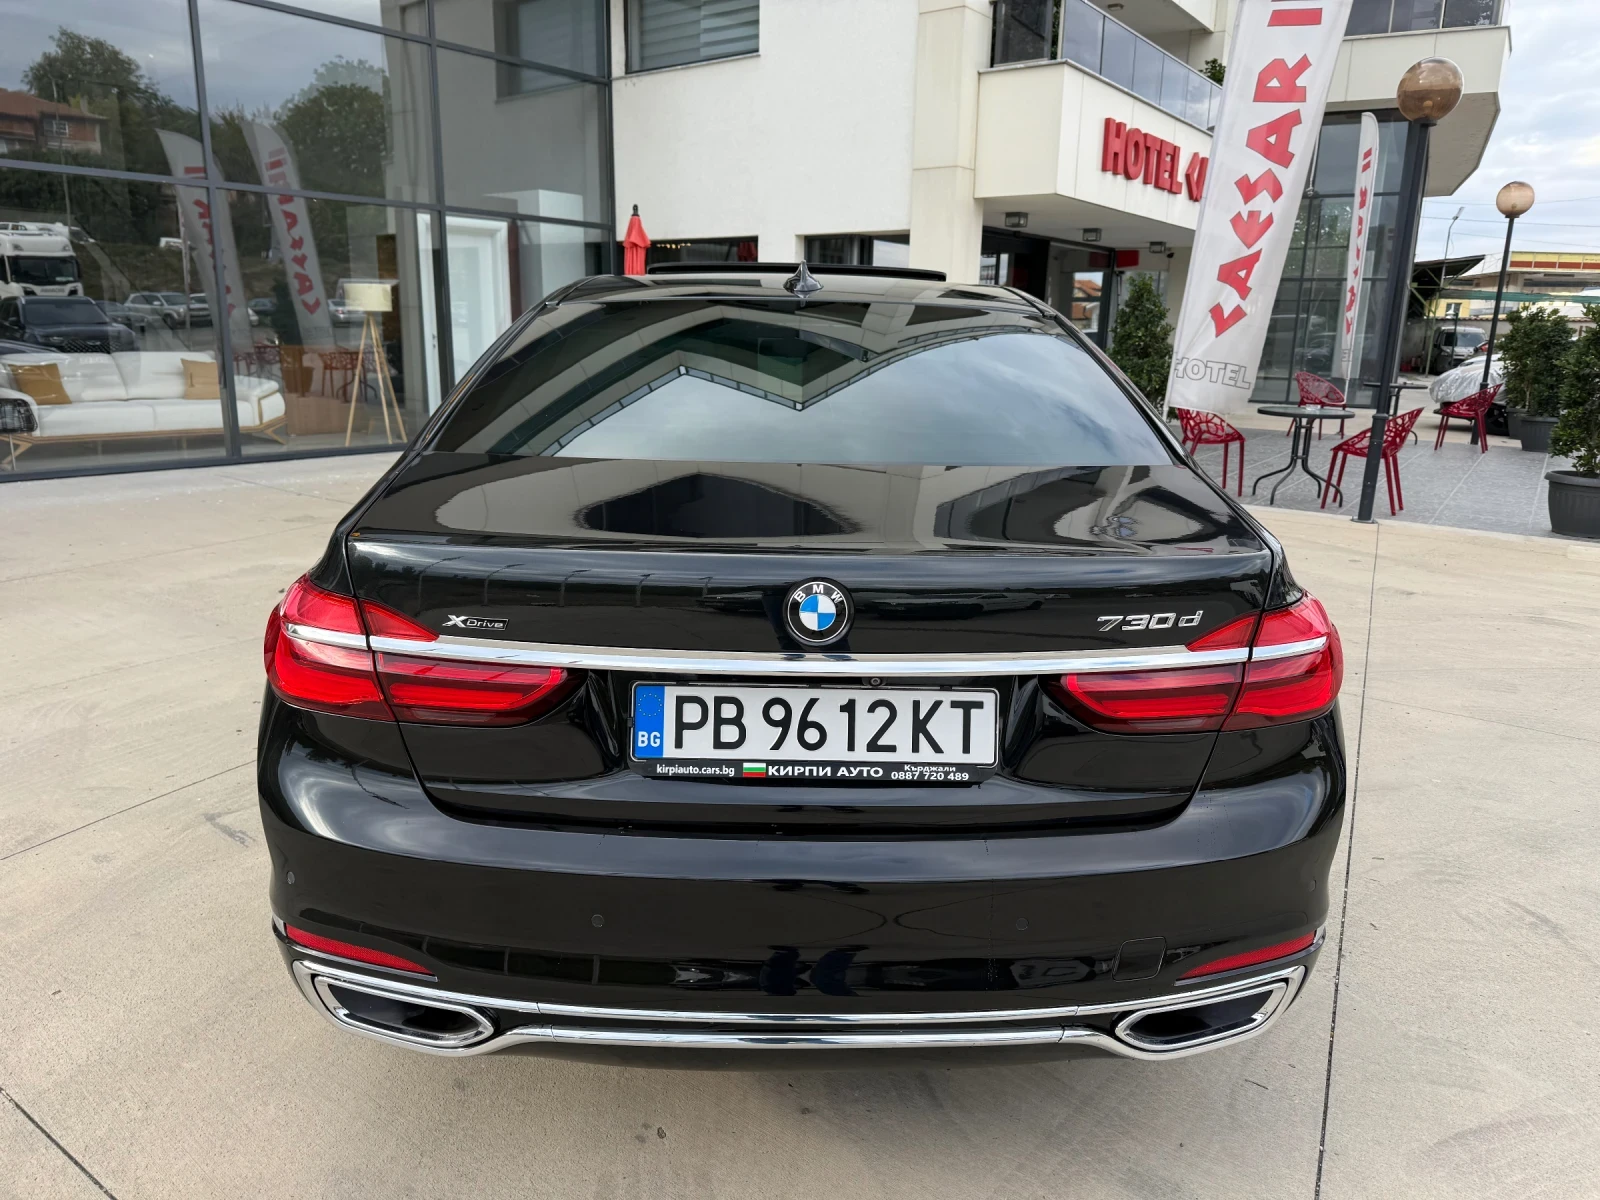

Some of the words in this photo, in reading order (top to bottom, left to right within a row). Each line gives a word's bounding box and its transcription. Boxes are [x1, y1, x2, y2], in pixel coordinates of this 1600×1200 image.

[1102, 117, 1183, 195] HOTEL
[1209, 53, 1312, 338] CAESAR
[793, 584, 844, 604] BMW
[674, 695, 747, 750] PB
[761, 697, 898, 752] 9612
[911, 699, 985, 755] KT
[637, 731, 661, 748] BG
[656, 764, 735, 776] kirpiauto.cars.bg
[768, 765, 832, 777] КИРПИ
[836, 766, 884, 778] АУТО
[891, 771, 919, 780] 0887
[924, 772, 945, 781] 720
[947, 773, 969, 781] 489
[904, 764, 956, 773] Кърджали
